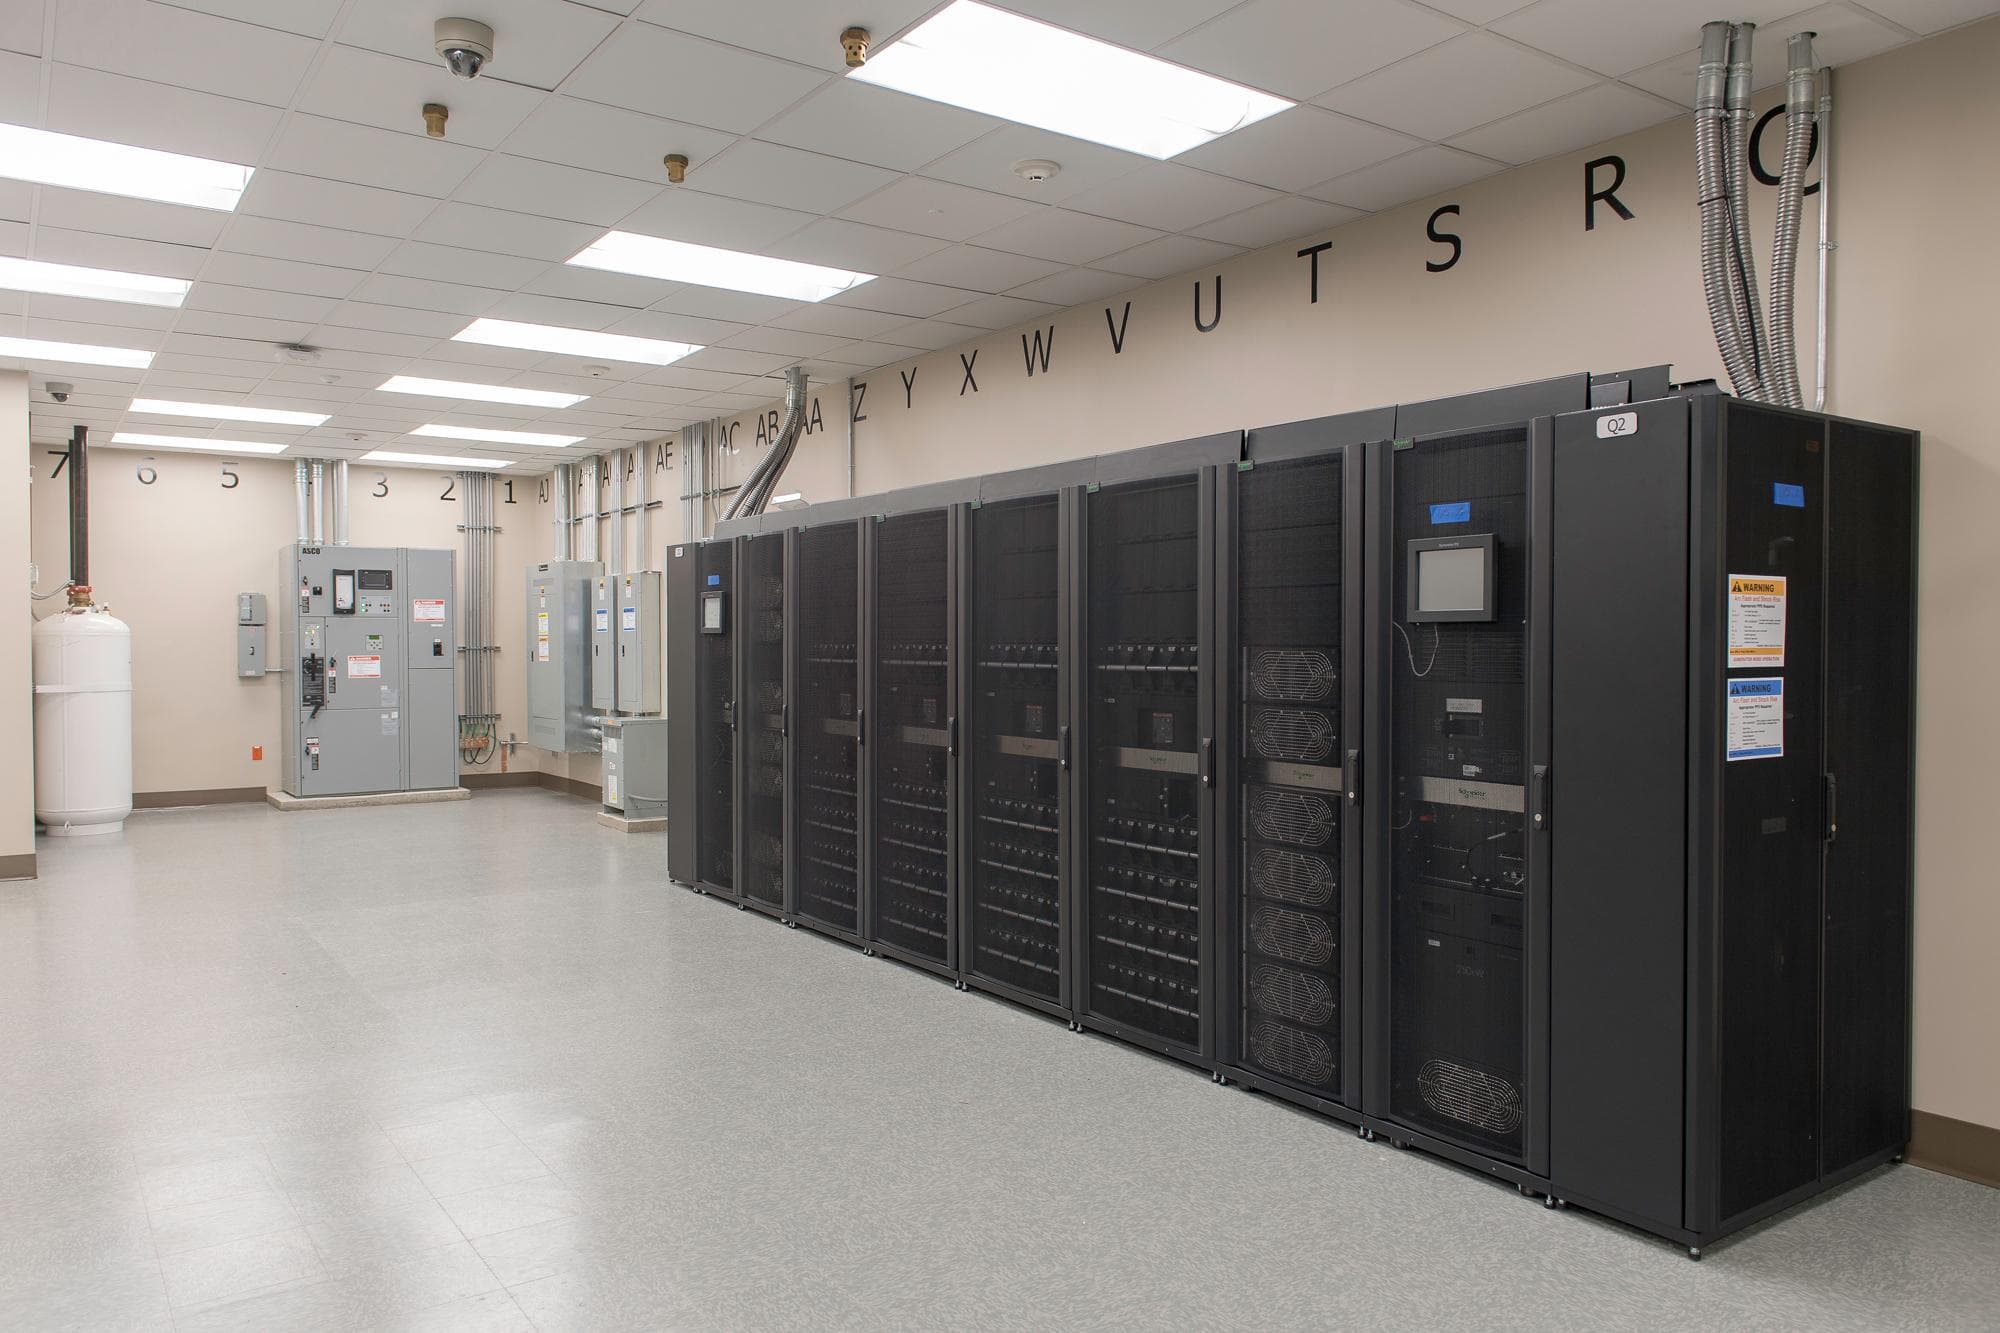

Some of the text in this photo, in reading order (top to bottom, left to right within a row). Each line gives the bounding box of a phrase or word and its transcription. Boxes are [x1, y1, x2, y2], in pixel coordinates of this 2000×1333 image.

[1585, 155, 1634, 231] R
[1426, 205, 1461, 272] S
[1297, 241, 1332, 303] T
[1195, 275, 1221, 332] U
[1105, 302, 1131, 354] V
[1022, 325, 1054, 376] W
[901, 367, 917, 408] Y
[960, 349, 978, 395] X
[853, 382, 867, 422] Z
[720, 421, 741, 456] AC
[756, 410, 779, 447] AB
[1607, 417, 1627, 435] Q2
[48, 450, 70, 479] 7
[137, 456, 157, 485] 6
[655, 441, 673, 474] AE
[221, 461, 239, 489] 5
[372, 471, 389, 497] 3
[439, 475, 456, 501] 2
[504, 479, 517, 504] 1
[538, 478, 549, 504] AJ
[302, 547, 321, 555] ASCO
[1743, 583, 1775, 593] WARNING
[1741, 684, 1771, 693] WARNING
